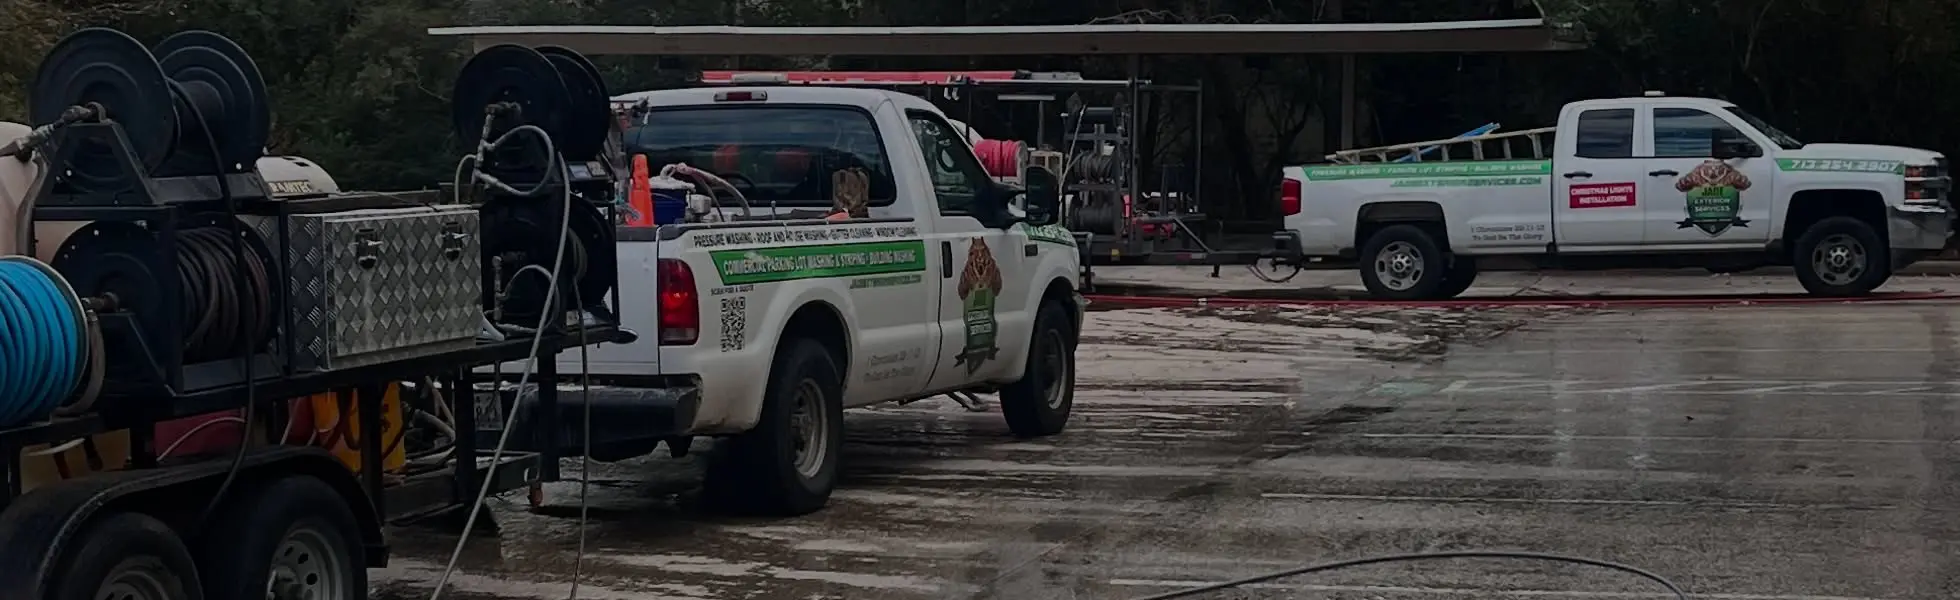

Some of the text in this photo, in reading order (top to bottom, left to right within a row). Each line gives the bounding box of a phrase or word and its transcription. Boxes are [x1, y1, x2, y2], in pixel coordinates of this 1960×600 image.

[1791, 159, 1901, 172] 713 254 2907
[1571, 185, 1633, 196] CHRISTMAS LIGHTS
[1579, 195, 1627, 204] INSTALLATION
[1694, 198, 1731, 206] EXTERIOR
[693, 233, 725, 247] PRESSURE
[726, 231, 753, 245] WASHING
[757, 231, 772, 244] ROOF
[773, 231, 786, 242] AND
[850, 228, 874, 240] CLEANING
[723, 257, 767, 276] COMMERCIAL
[768, 255, 795, 273] PARKING
[795, 254, 807, 271] LOT
[807, 254, 834, 269] WASHING
[869, 251, 893, 265] BUILDING
